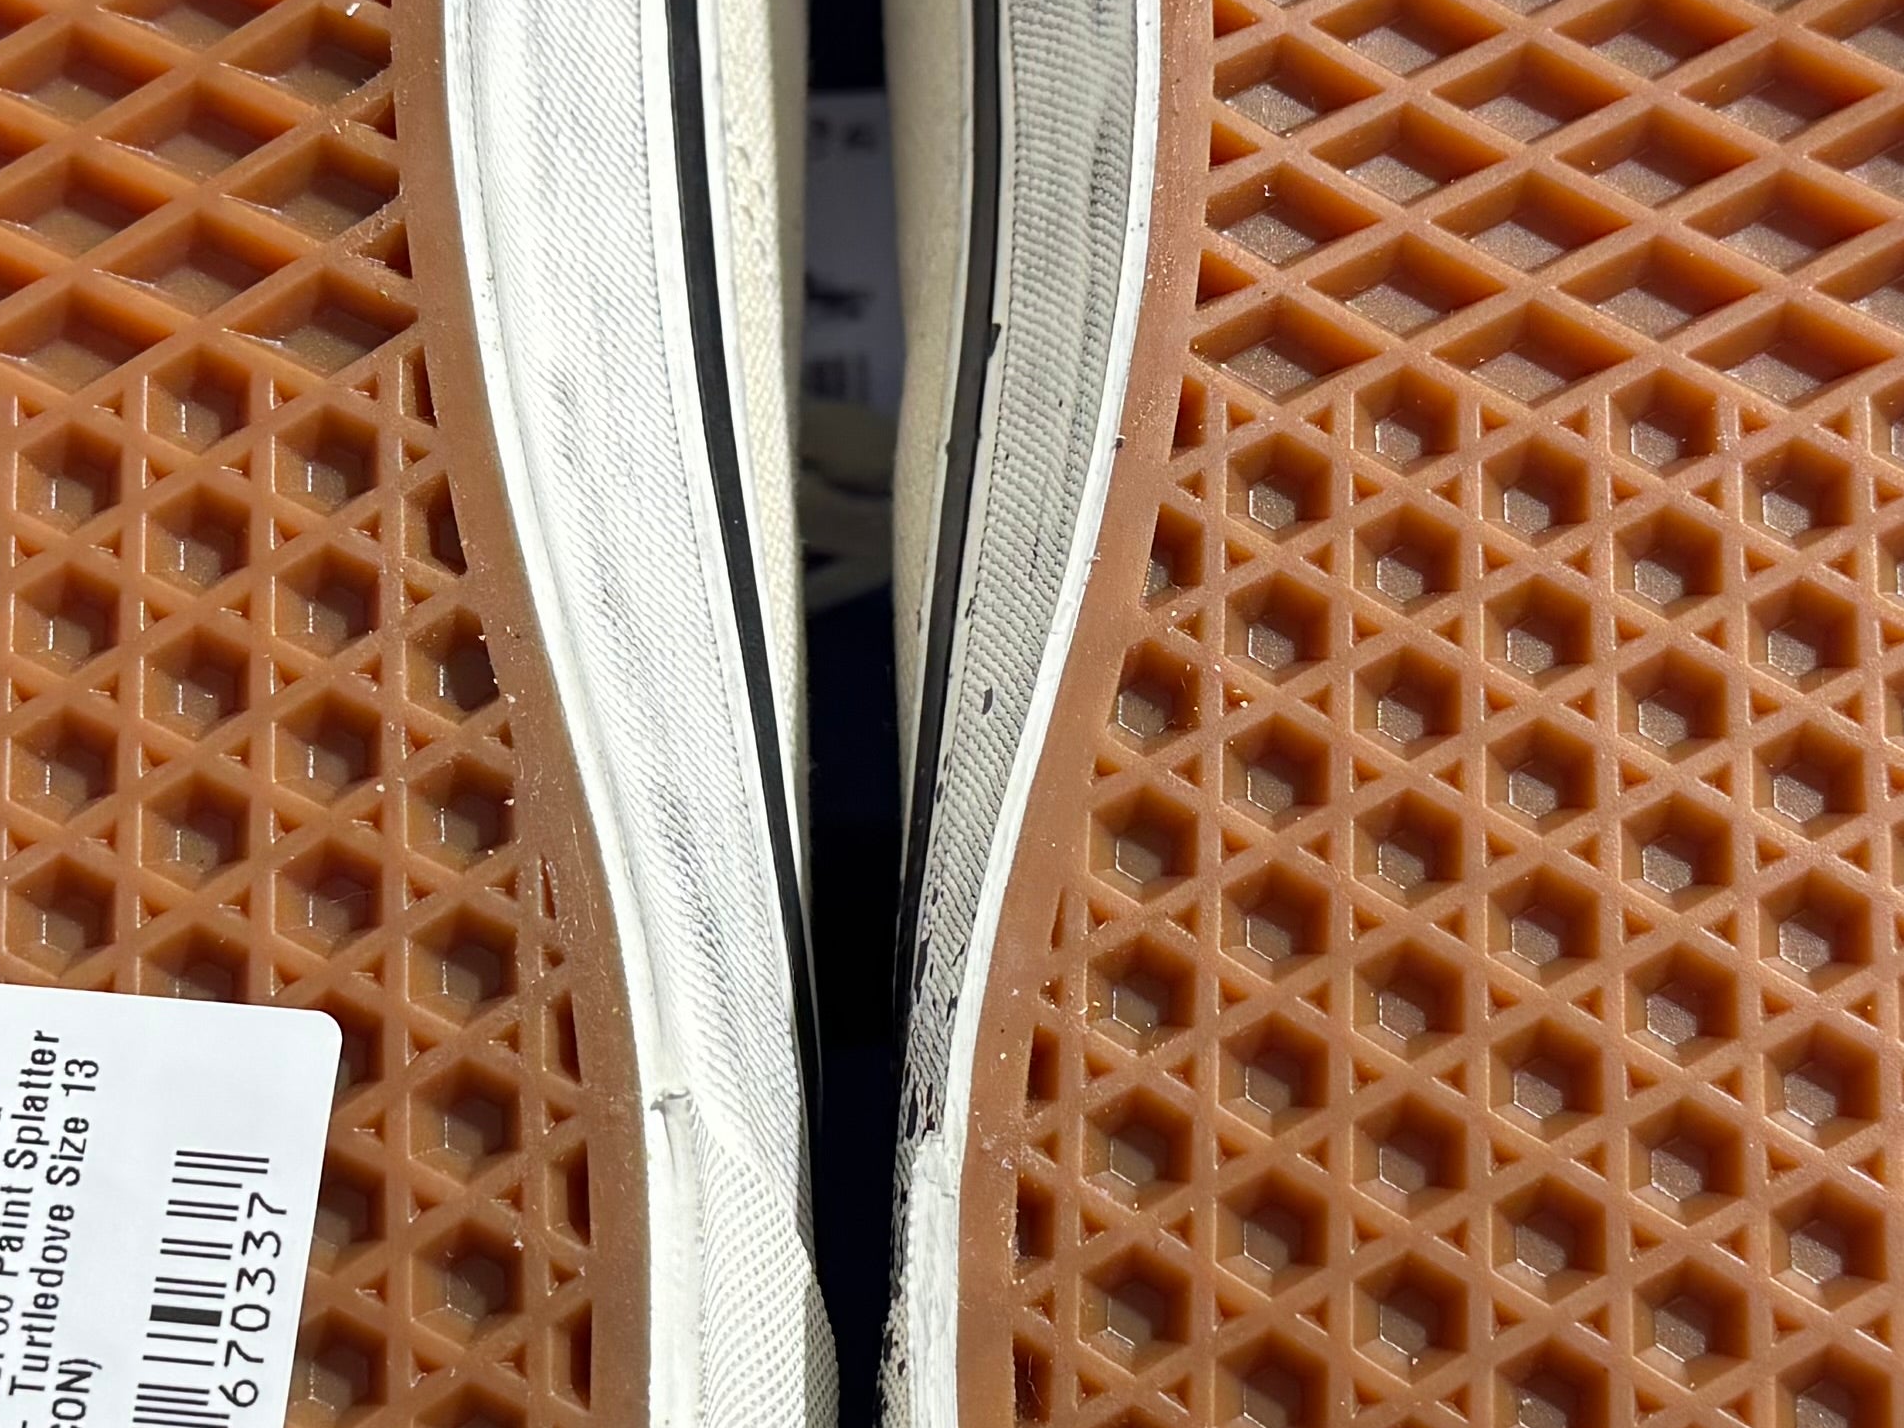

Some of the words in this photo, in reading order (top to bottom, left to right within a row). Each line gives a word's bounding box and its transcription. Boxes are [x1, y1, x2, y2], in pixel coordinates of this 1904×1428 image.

[3, 1029, 60, 1170] Splatter
[60, 1058, 100, 1097] 13
[45, 1116, 90, 1188] Size
[8, 1203, 75, 1396] Turtledove
[217, 1191, 287, 1408] 670337
